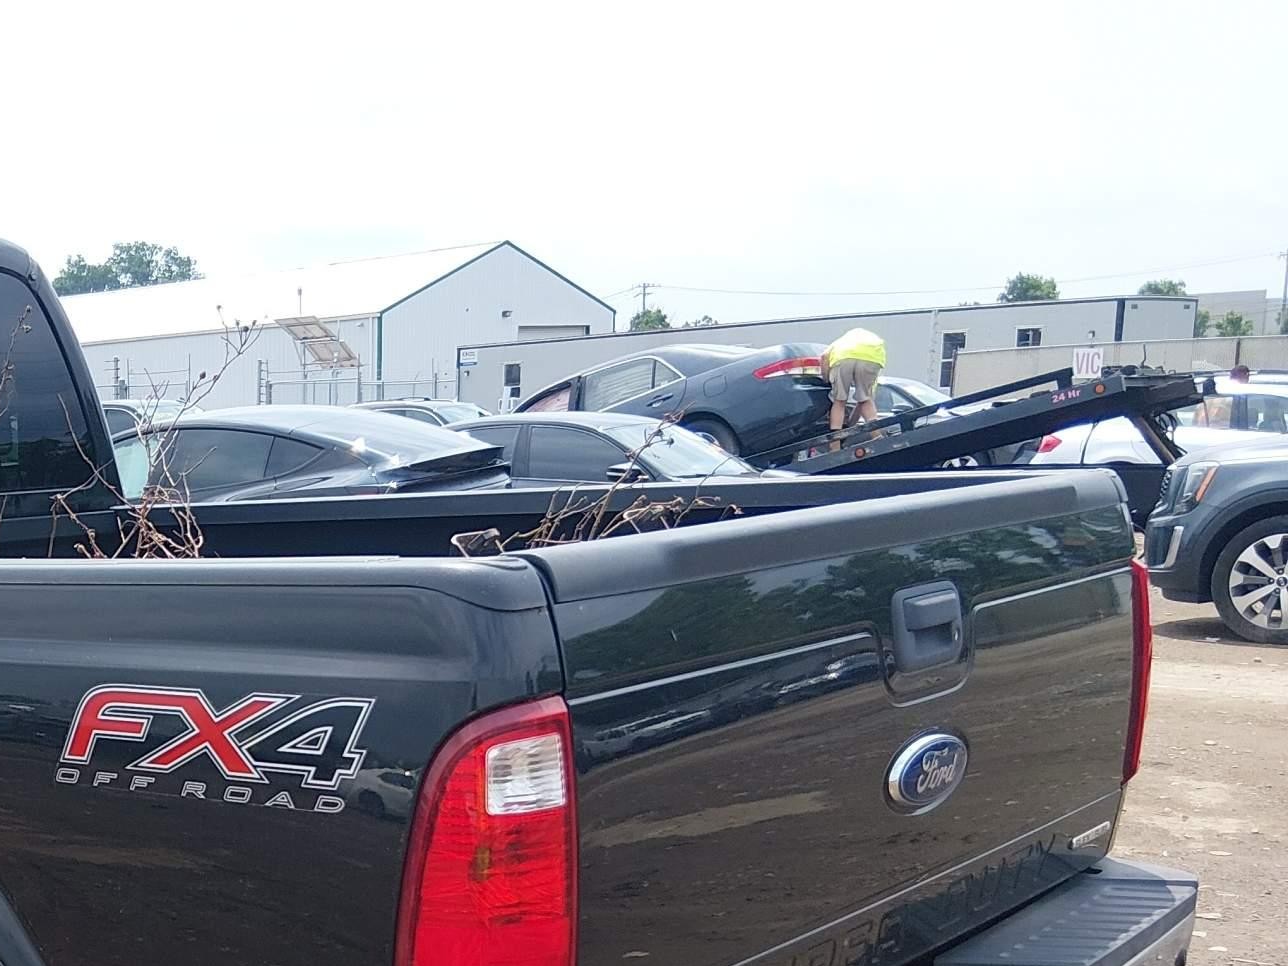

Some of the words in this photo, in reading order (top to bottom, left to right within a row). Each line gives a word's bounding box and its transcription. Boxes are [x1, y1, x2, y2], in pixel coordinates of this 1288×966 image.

[1075, 351, 1101, 375] VIC
[1051, 393, 1066, 403] 24
[1067, 390, 1081, 399] Hr
[59, 683, 377, 791] FX4
[55, 767, 155, 791] OFF
[180, 781, 346, 814] ROAD
[916, 747, 958, 794] Ford
